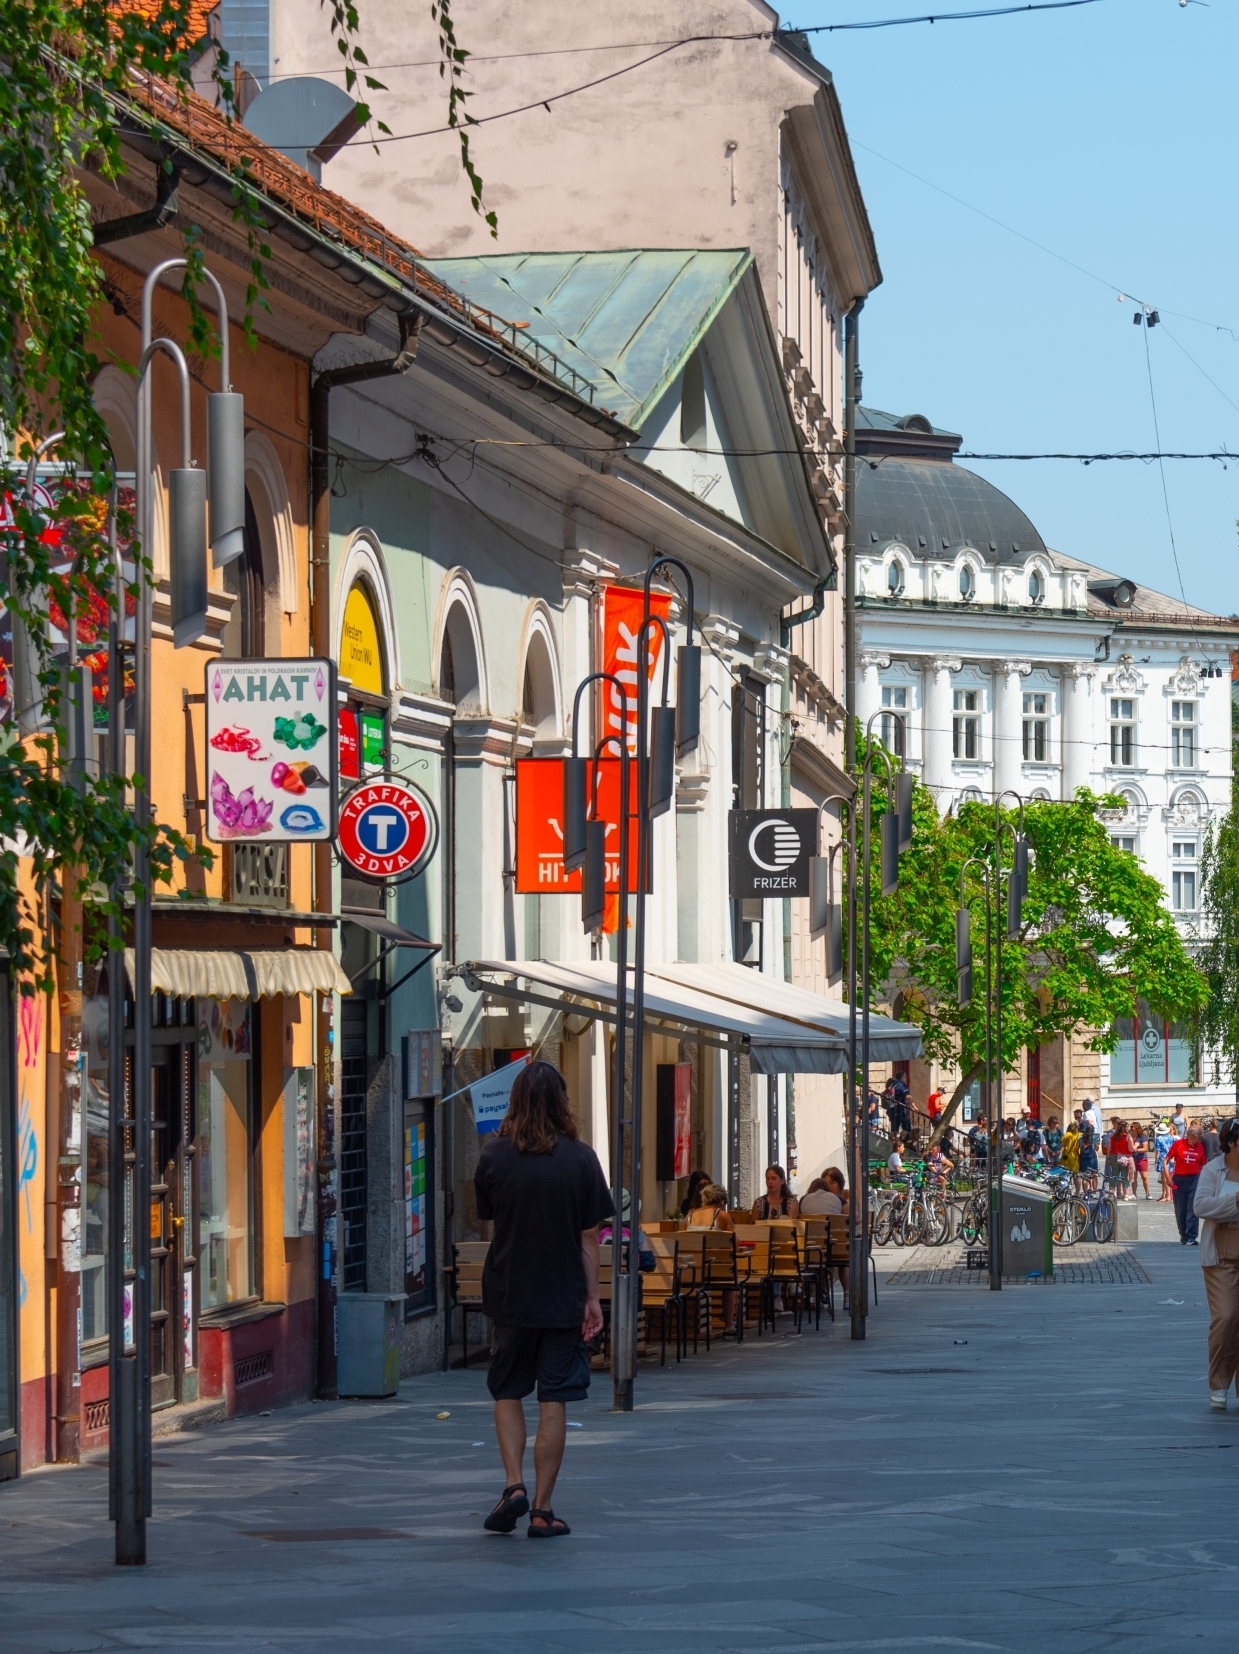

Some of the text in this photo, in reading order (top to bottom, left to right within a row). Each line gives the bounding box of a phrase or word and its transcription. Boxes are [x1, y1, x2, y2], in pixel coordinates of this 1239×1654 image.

[344, 620, 363, 643] Western
[222, 674, 310, 703] AHAT
[344, 788, 420, 822] TRAFIKA
[368, 815, 397, 849] T
[354, 852, 409, 872] 3DVA
[754, 877, 797, 889] FRIZER
[1139, 1060, 1164, 1069] Ljubljana
[485, 1102, 510, 1114] paysaf
